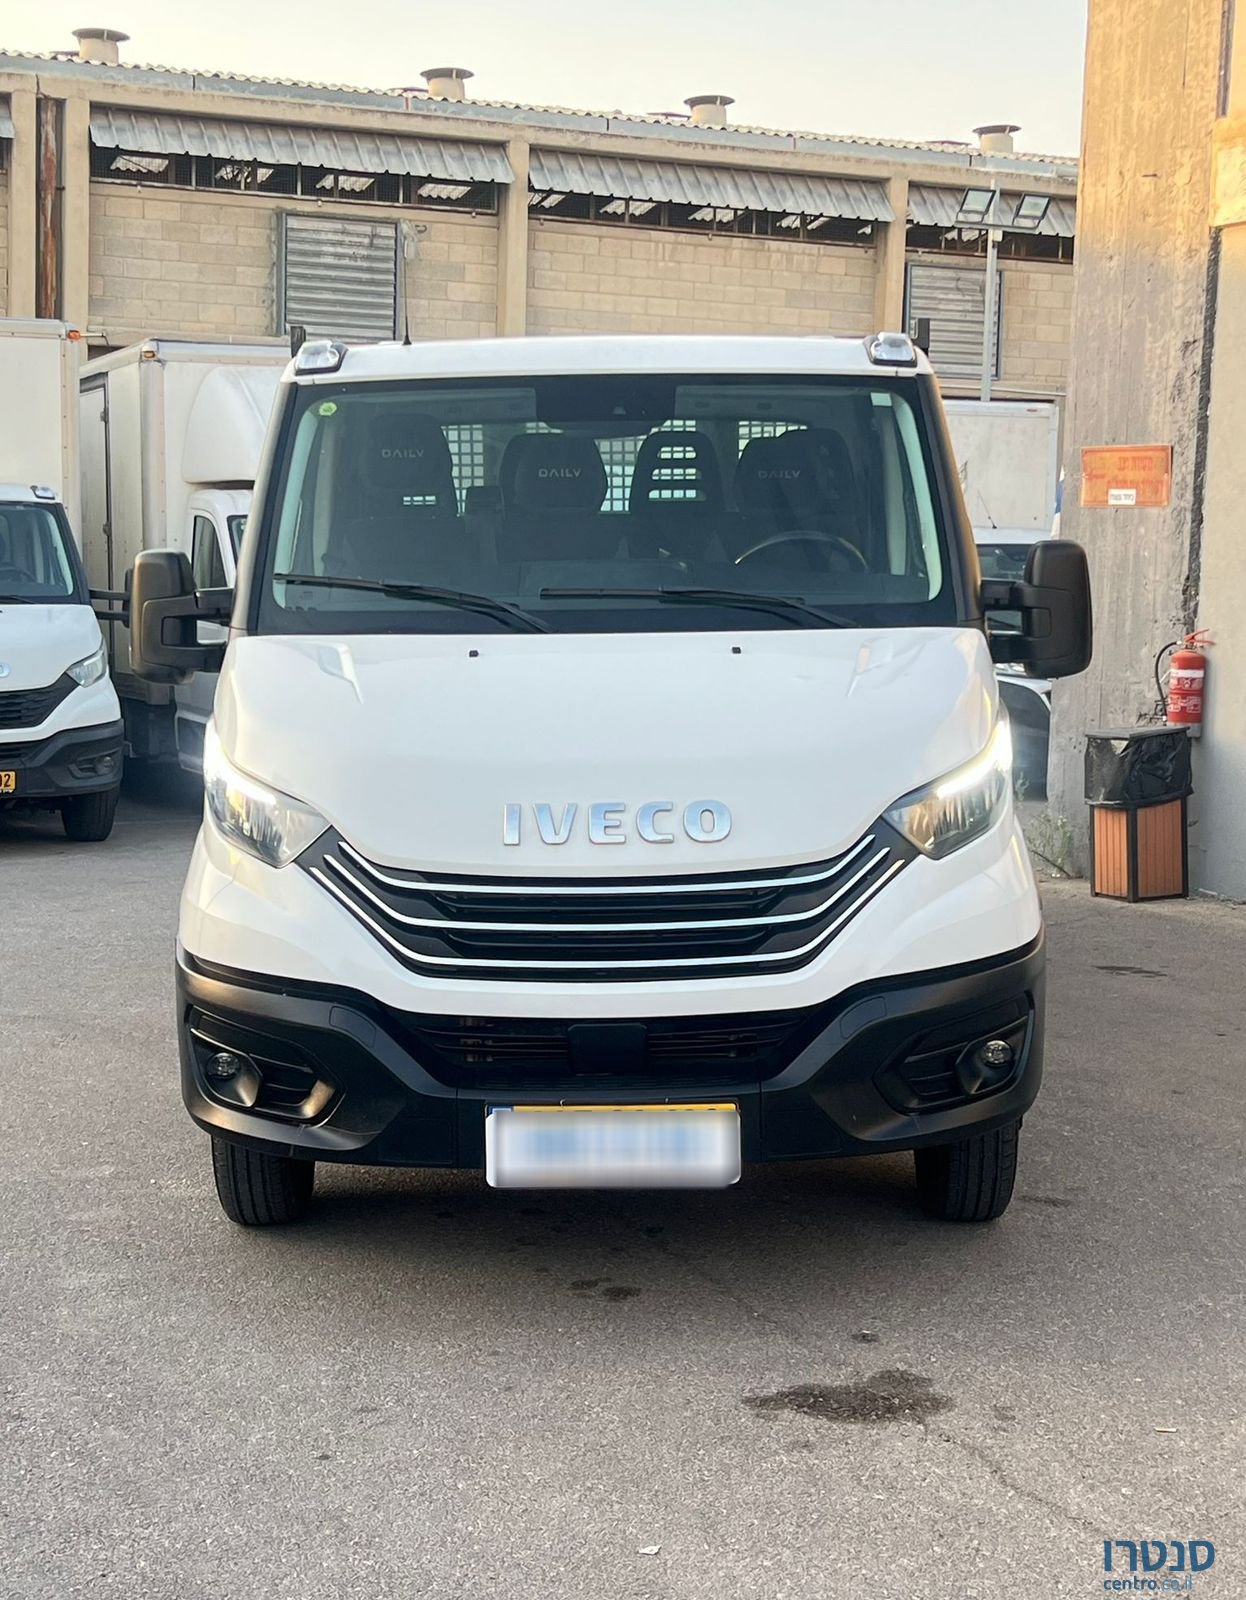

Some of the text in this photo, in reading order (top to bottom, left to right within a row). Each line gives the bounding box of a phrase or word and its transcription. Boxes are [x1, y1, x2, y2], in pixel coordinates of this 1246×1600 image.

[381, 447, 425, 458] DAILY
[538, 468, 582, 478] DAILY
[502, 799, 733, 847] IVECO
